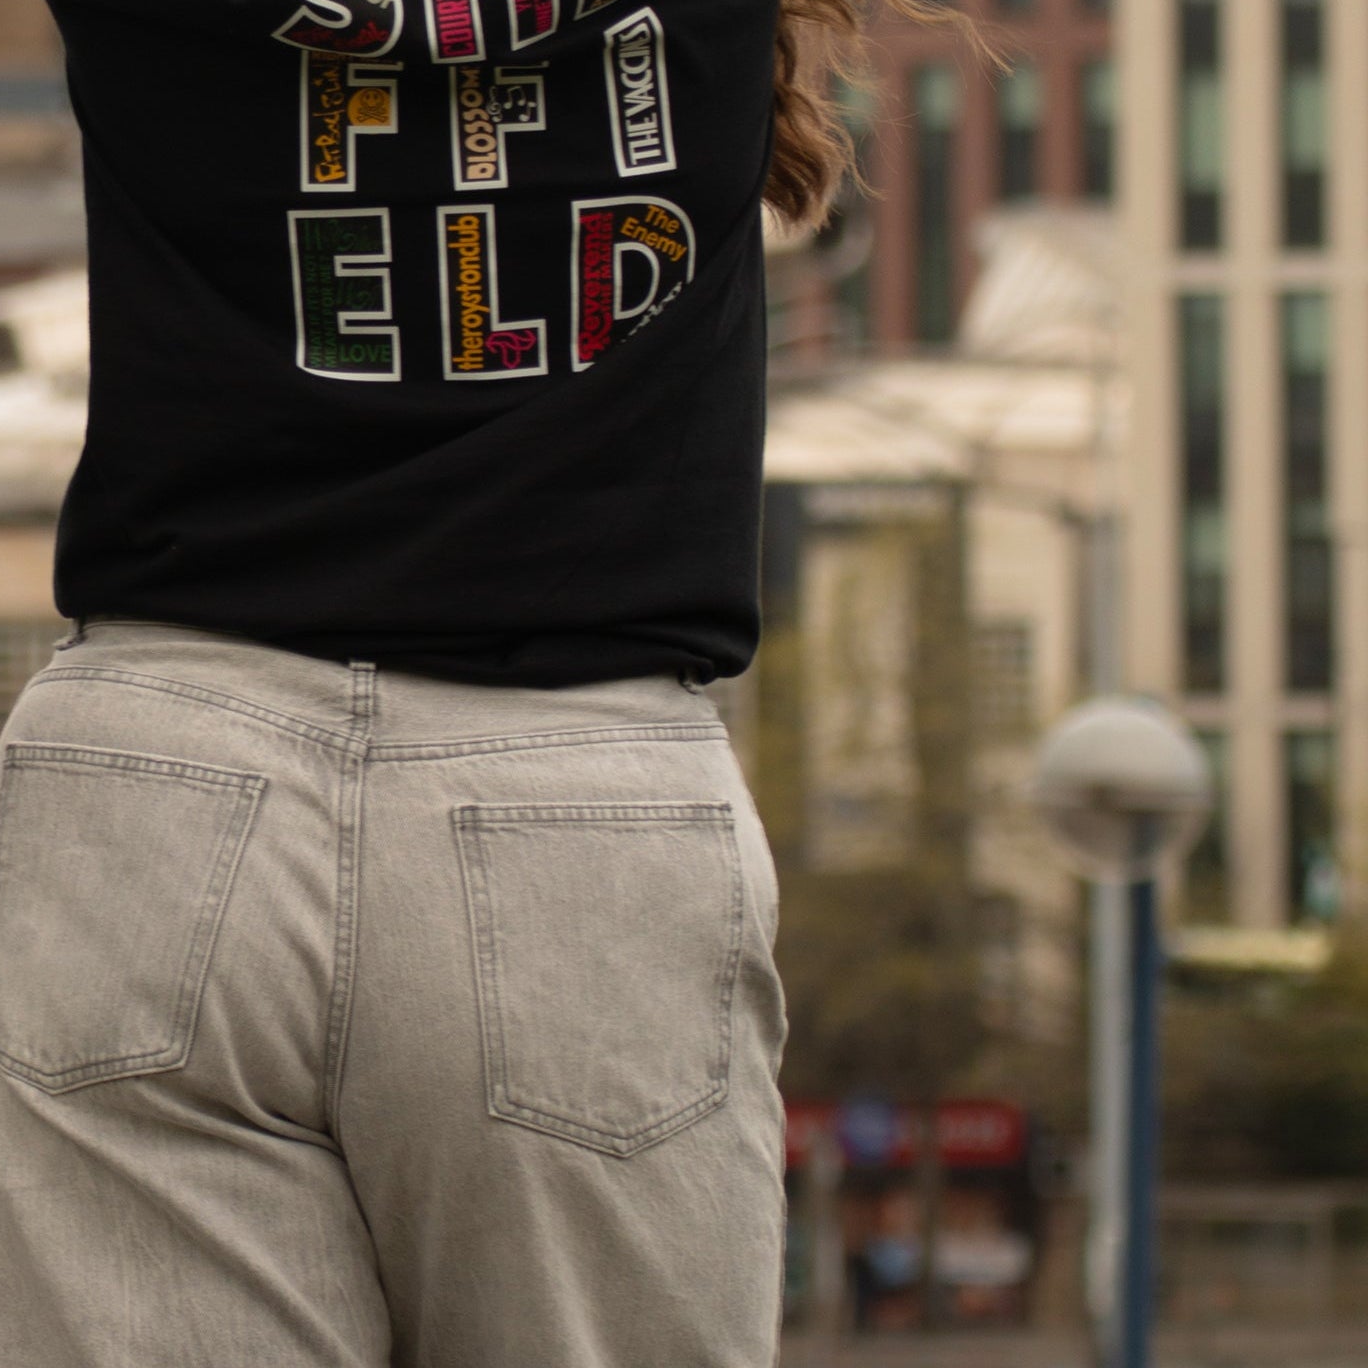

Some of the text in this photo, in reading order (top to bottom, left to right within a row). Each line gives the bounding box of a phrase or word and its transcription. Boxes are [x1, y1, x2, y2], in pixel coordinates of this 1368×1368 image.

[625, 112, 662, 165] THE
[619, 216, 688, 263] Enemy
[644, 203, 680, 234] The
[579, 211, 614, 361] Reverend
[339, 343, 392, 364] LOVE
